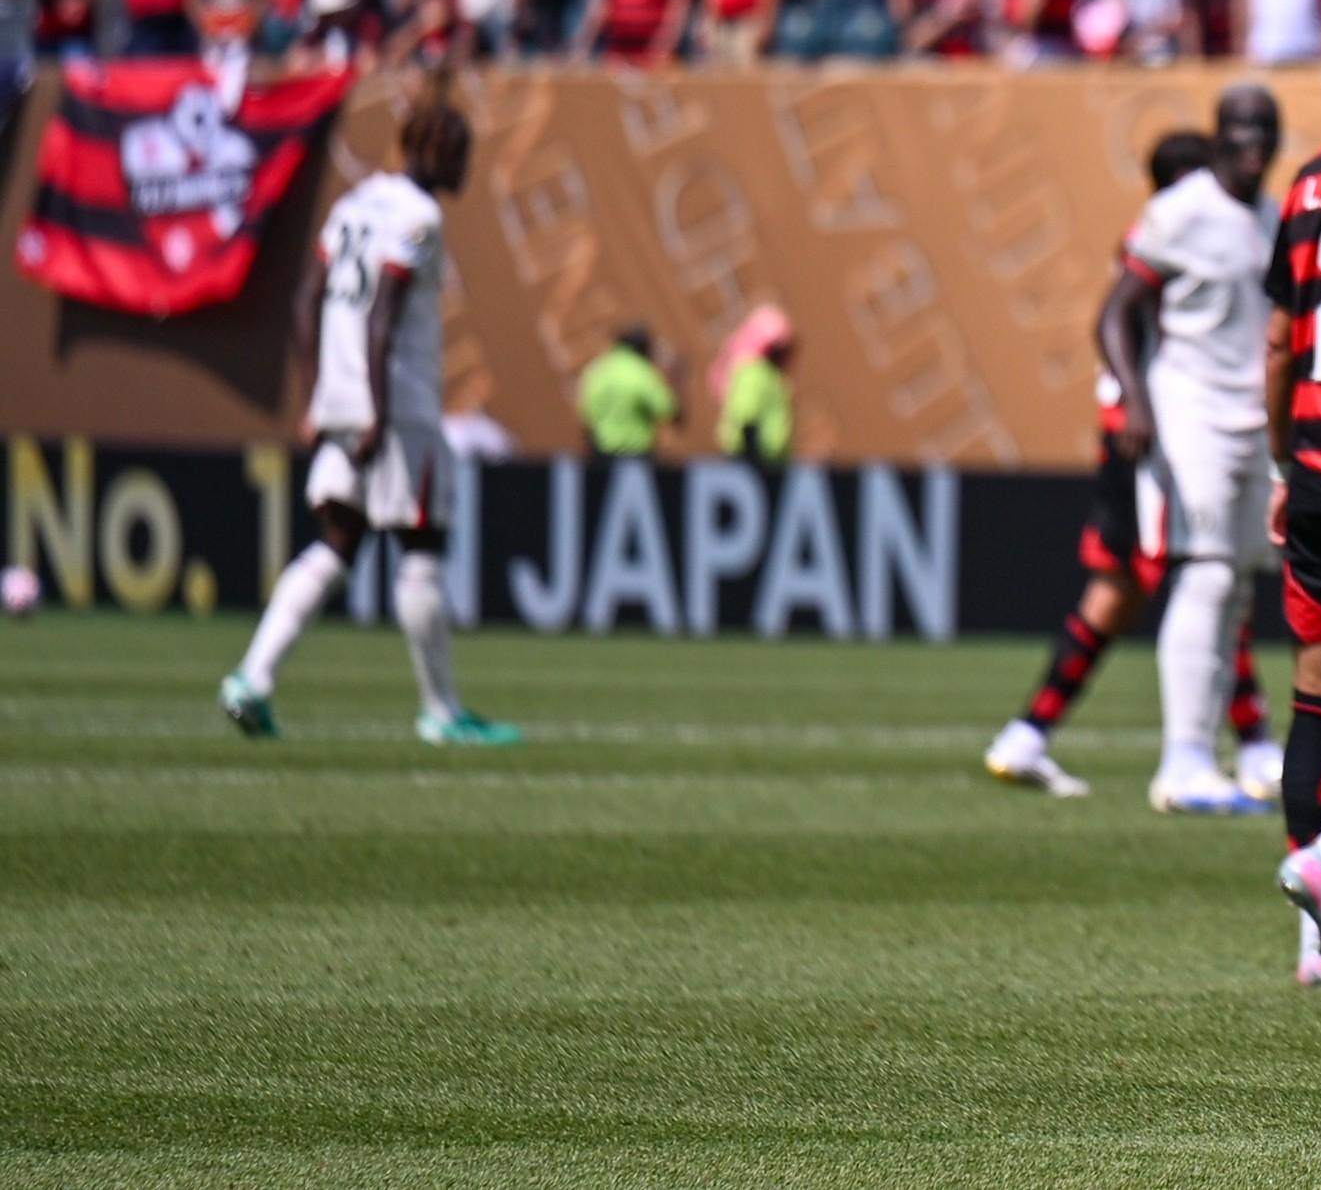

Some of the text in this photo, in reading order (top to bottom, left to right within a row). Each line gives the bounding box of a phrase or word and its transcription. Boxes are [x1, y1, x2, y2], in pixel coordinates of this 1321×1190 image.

[8, 435, 217, 617] No.
[244, 439, 292, 611] 1
[508, 453, 961, 643] JAPAN
